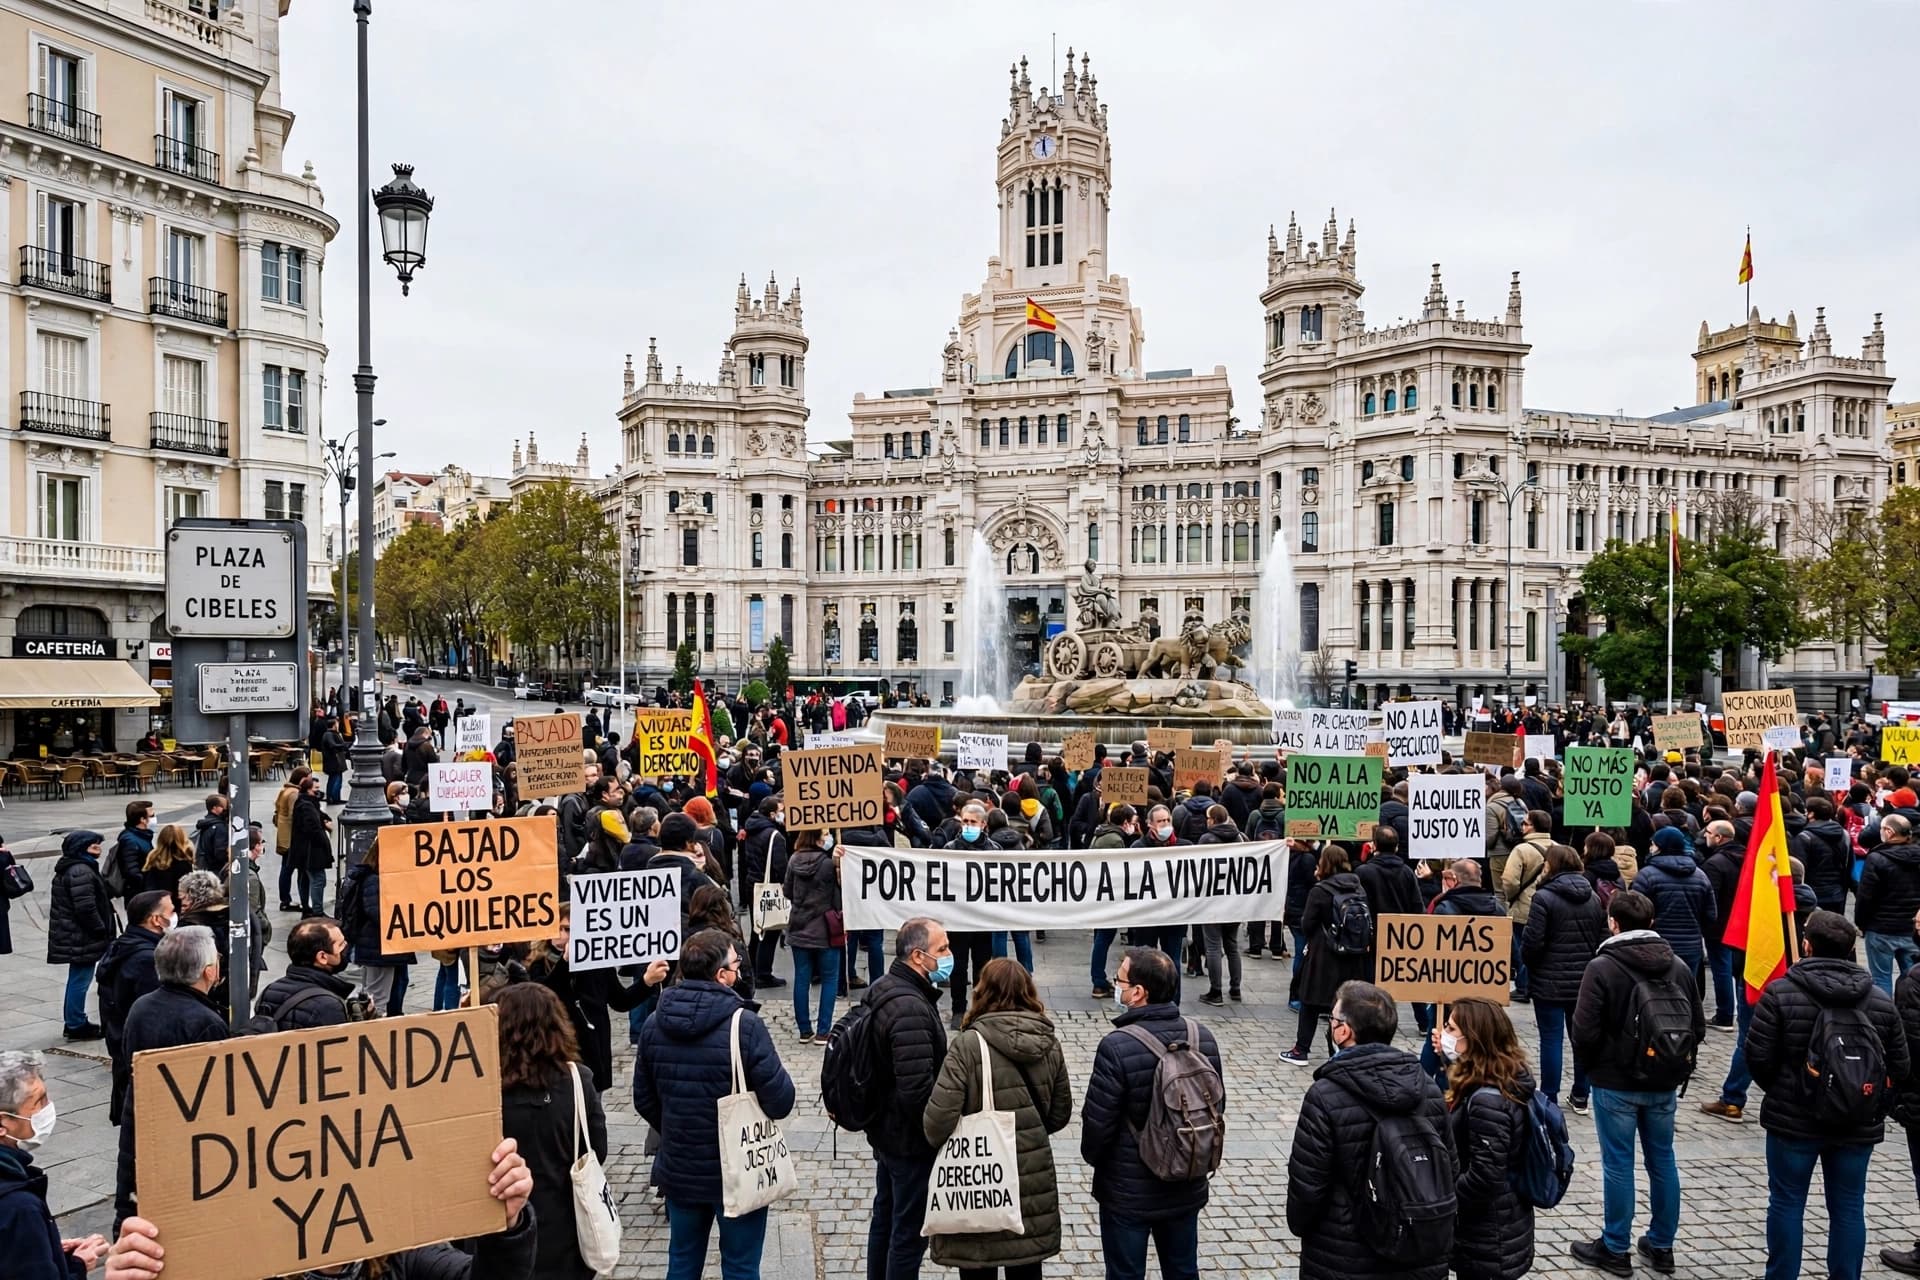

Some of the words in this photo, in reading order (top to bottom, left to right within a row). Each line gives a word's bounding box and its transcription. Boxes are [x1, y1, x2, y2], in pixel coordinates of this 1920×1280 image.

[196, 546, 266, 568] PLAZA
[221, 574, 241, 589] DE
[185, 597, 277, 619] CIBELES
[25, 640, 106, 656] CAFETERÍA
[51, 698, 102, 707] CAFETERÍA
[1387, 710, 1407, 731] NO
[1410, 709, 1420, 729] A
[1422, 708, 1439, 728] LA
[649, 735, 664, 750] ES
[669, 735, 687, 750] UN
[789, 752, 878, 778] VIVIENDA
[1293, 761, 1322, 785] NO
[1327, 762, 1341, 785] A
[1346, 763, 1369, 785] LA
[1571, 755, 1593, 774] NO
[1598, 750, 1628, 775] MÁS
[798, 780, 821, 801] ES
[827, 778, 854, 799] UN
[1567, 777, 1623, 796] JUSTO
[1412, 788, 1481, 811] ALQUILER
[1582, 799, 1605, 819] YA
[788, 799, 878, 827] DERECHO
[1317, 814, 1339, 836] YA
[1411, 818, 1459, 840] JUSTO
[1462, 817, 1481, 838] YA
[414, 825, 520, 867] BAJAD
[440, 866, 493, 895] LOS
[574, 873, 677, 904] VIVIENDA
[861, 858, 916, 902] POR
[926, 860, 956, 902] EL
[965, 860, 1088, 903] DERECHO
[1096, 861, 1115, 902] A
[1123, 860, 1157, 901] LA
[1165, 854, 1273, 899] VIVIENDA
[386, 891, 556, 941] ALQUILERES
[585, 907, 613, 933] ES
[620, 904, 649, 930] UN
[574, 929, 679, 963] DERECHO
[1386, 922, 1425, 951] NO
[1436, 917, 1494, 953] MÁS
[1380, 956, 1508, 986] DESAHUCIOS
[157, 1021, 484, 1122] VIVIENDA
[191, 1104, 413, 1201] DIGNA
[945, 1137, 970, 1159] POR
[975, 1136, 993, 1157] EL
[765, 1166, 778, 1187] YA
[937, 1163, 1003, 1188] DERECHO
[930, 1192, 941, 1211] A
[945, 1188, 1013, 1211] VIVIENDA
[273, 1183, 374, 1260] YA
